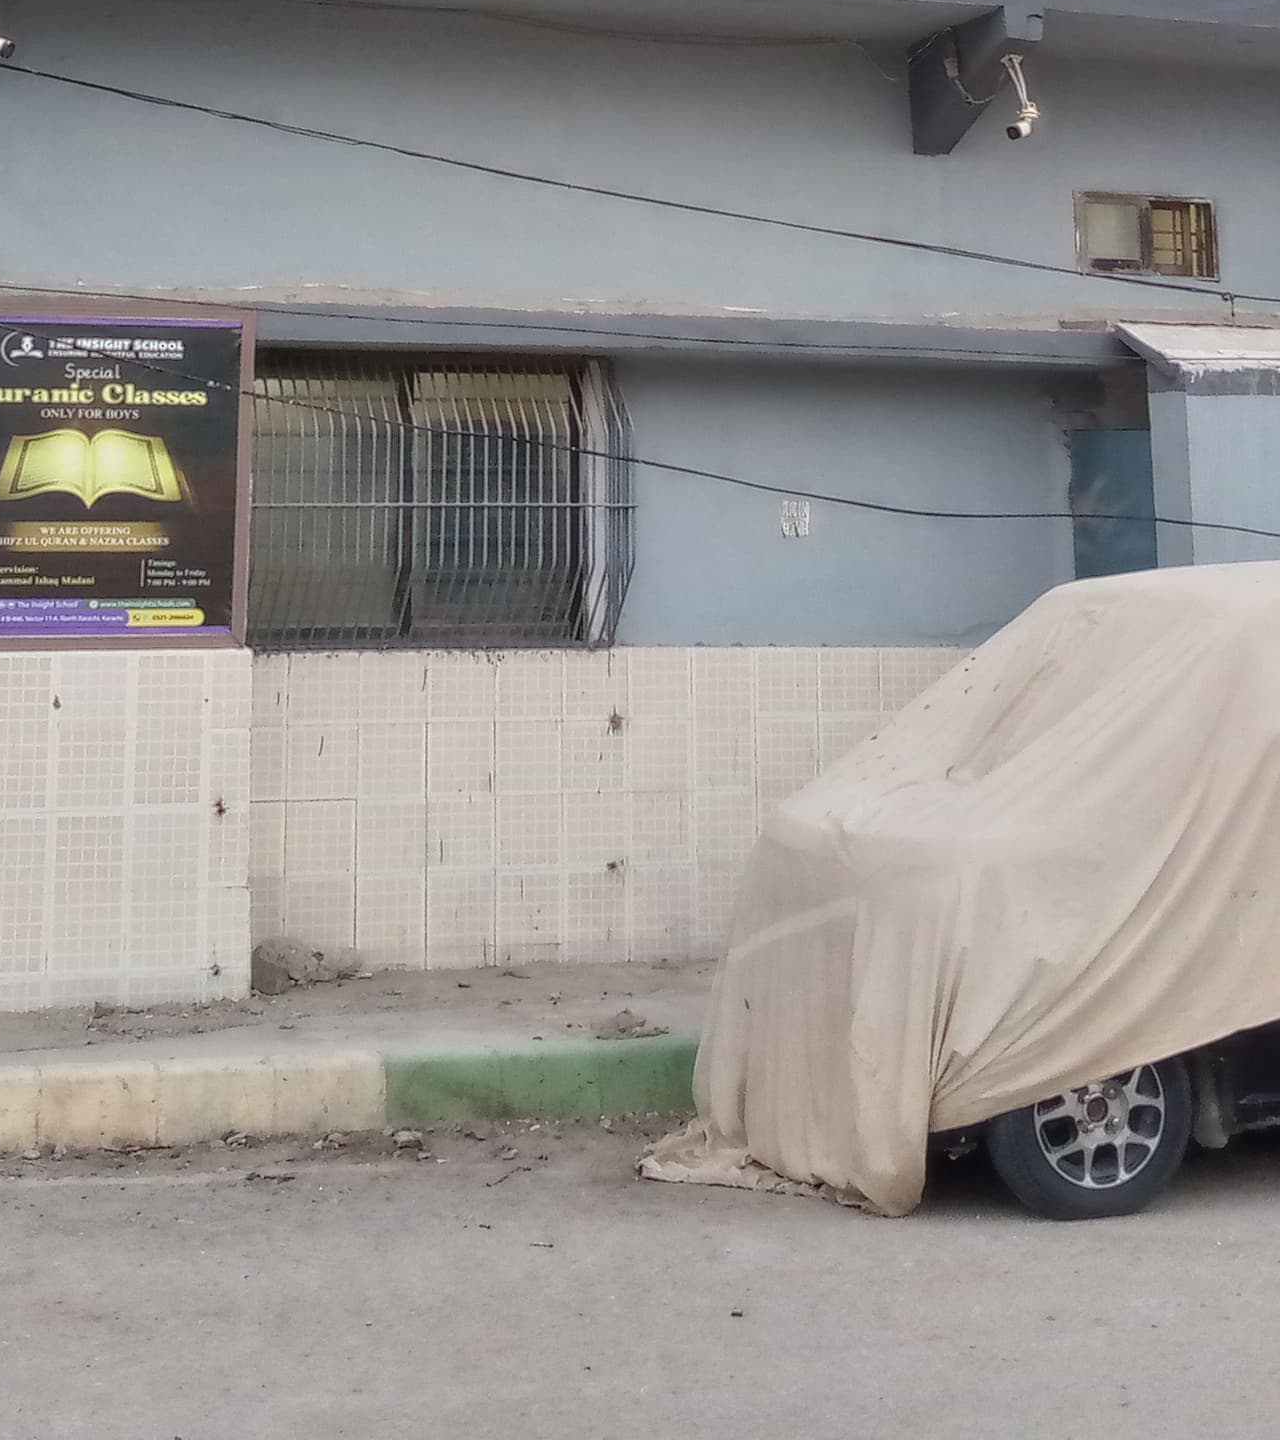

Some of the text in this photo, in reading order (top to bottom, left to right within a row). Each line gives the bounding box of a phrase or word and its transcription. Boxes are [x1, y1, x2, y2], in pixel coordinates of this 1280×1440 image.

[75, 338, 132, 350] INSIGHT
[133, 340, 184, 351] SCHOOL
[64, 363, 120, 383] Special
[102, 383, 208, 406] Classes
[41, 408, 140, 419] ONLY FOR BOYS
[40, 527, 131, 535] WE ARE OFFERING
[0, 537, 23, 546] HIFZ
[24, 537, 39, 545] UL
[40, 537, 77, 547] QURAN
[90, 537, 125, 546] NAZRA
[126, 537, 170, 546] CLASSES
[61, 576, 96, 585] Madani
